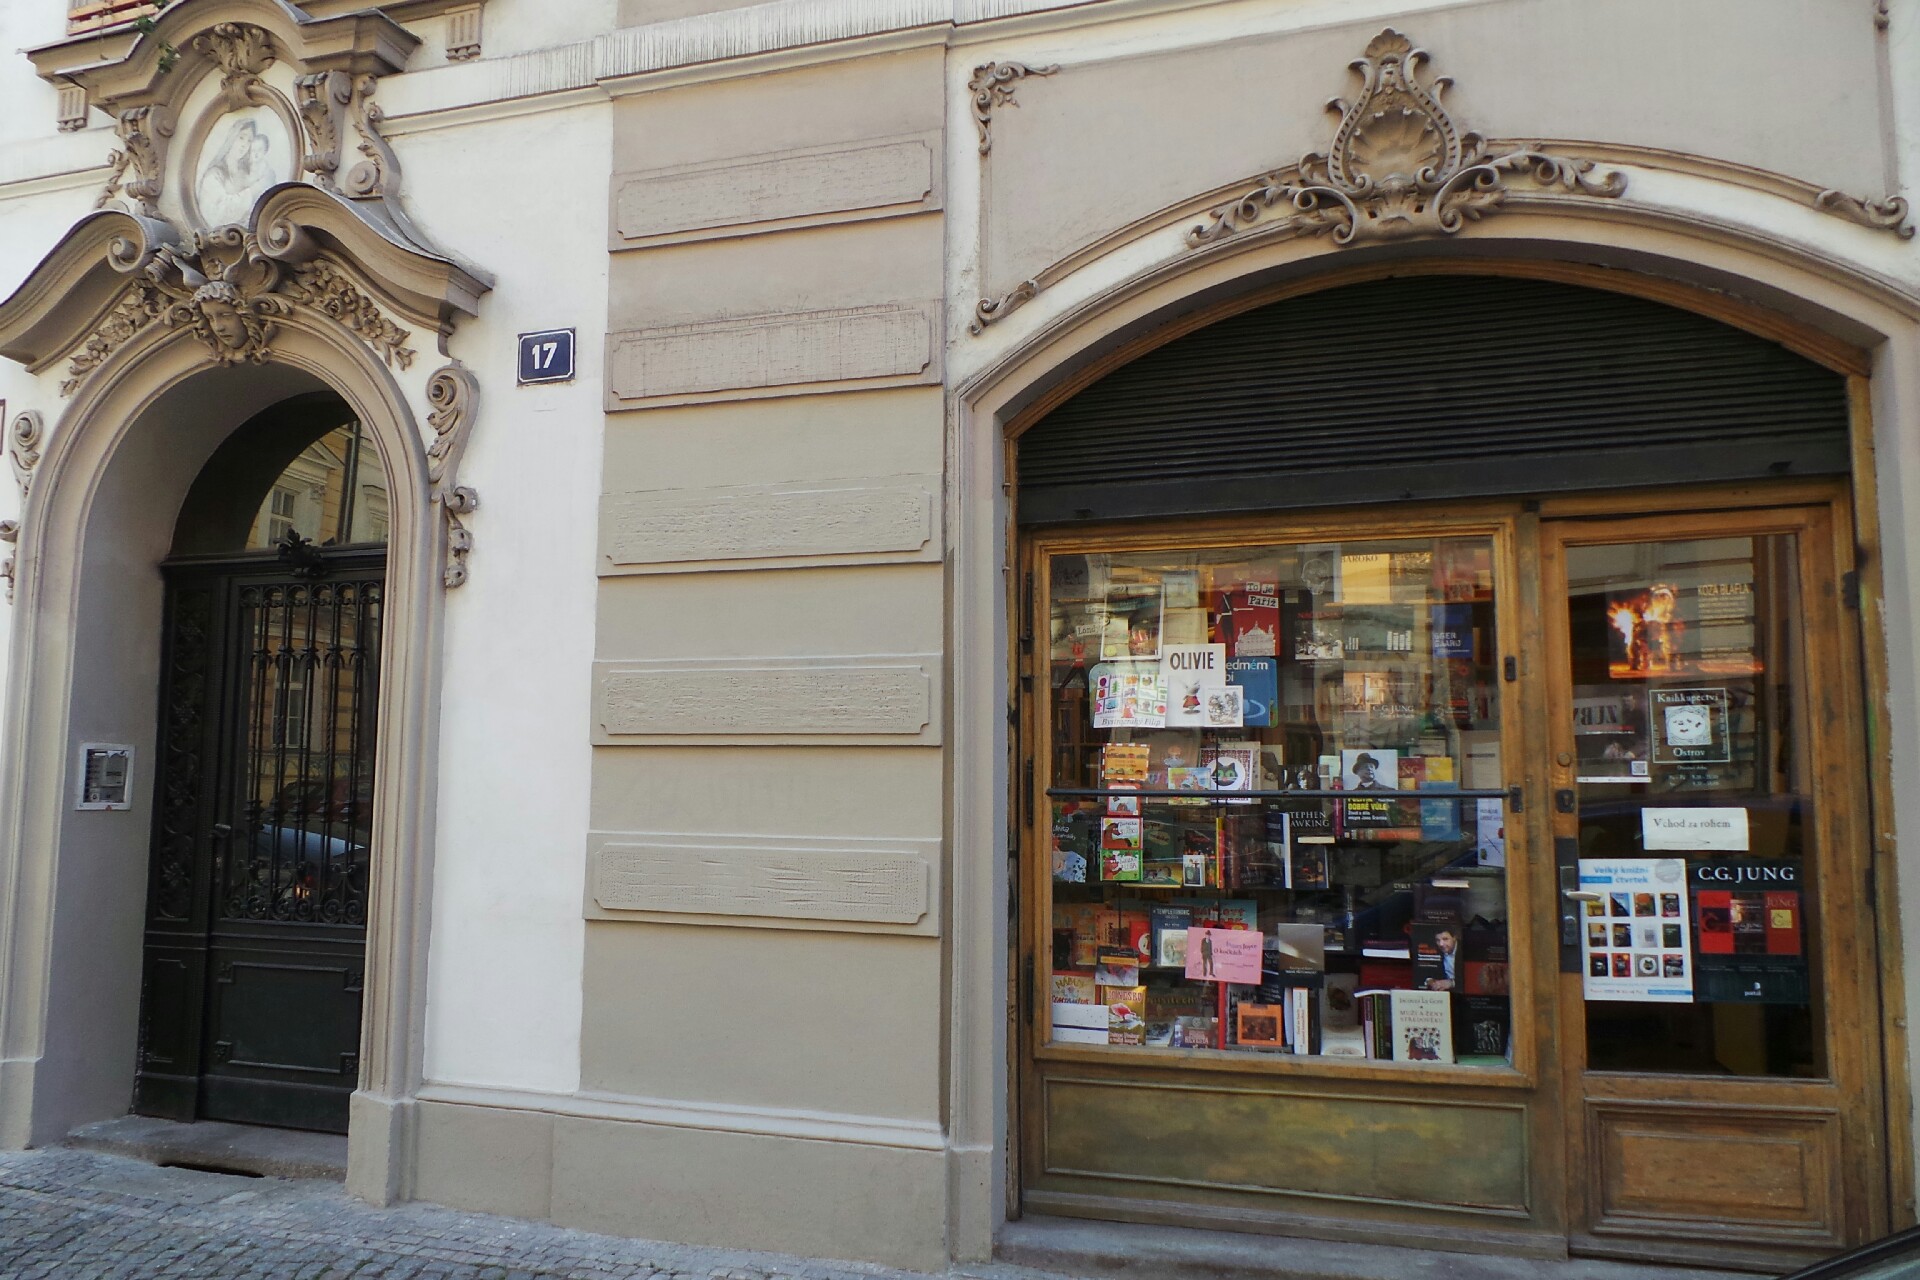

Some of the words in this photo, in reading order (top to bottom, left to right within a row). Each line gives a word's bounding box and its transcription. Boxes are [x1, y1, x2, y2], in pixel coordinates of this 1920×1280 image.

[532, 342, 558, 370] 17
[1247, 583, 1259, 591] To
[1262, 585, 1273, 594] je
[1169, 651, 1214, 671] OLIVIE
[1226, 659, 1268, 670] edmém
[1673, 747, 1706, 757] Ostrov
[1290, 811, 1326, 819] TEPHEN
[1290, 819, 1330, 827] AWKING
[1699, 819, 1731, 828] rohem
[1698, 866, 1733, 880] C.G.
[1735, 867, 1794, 883] JUNG
